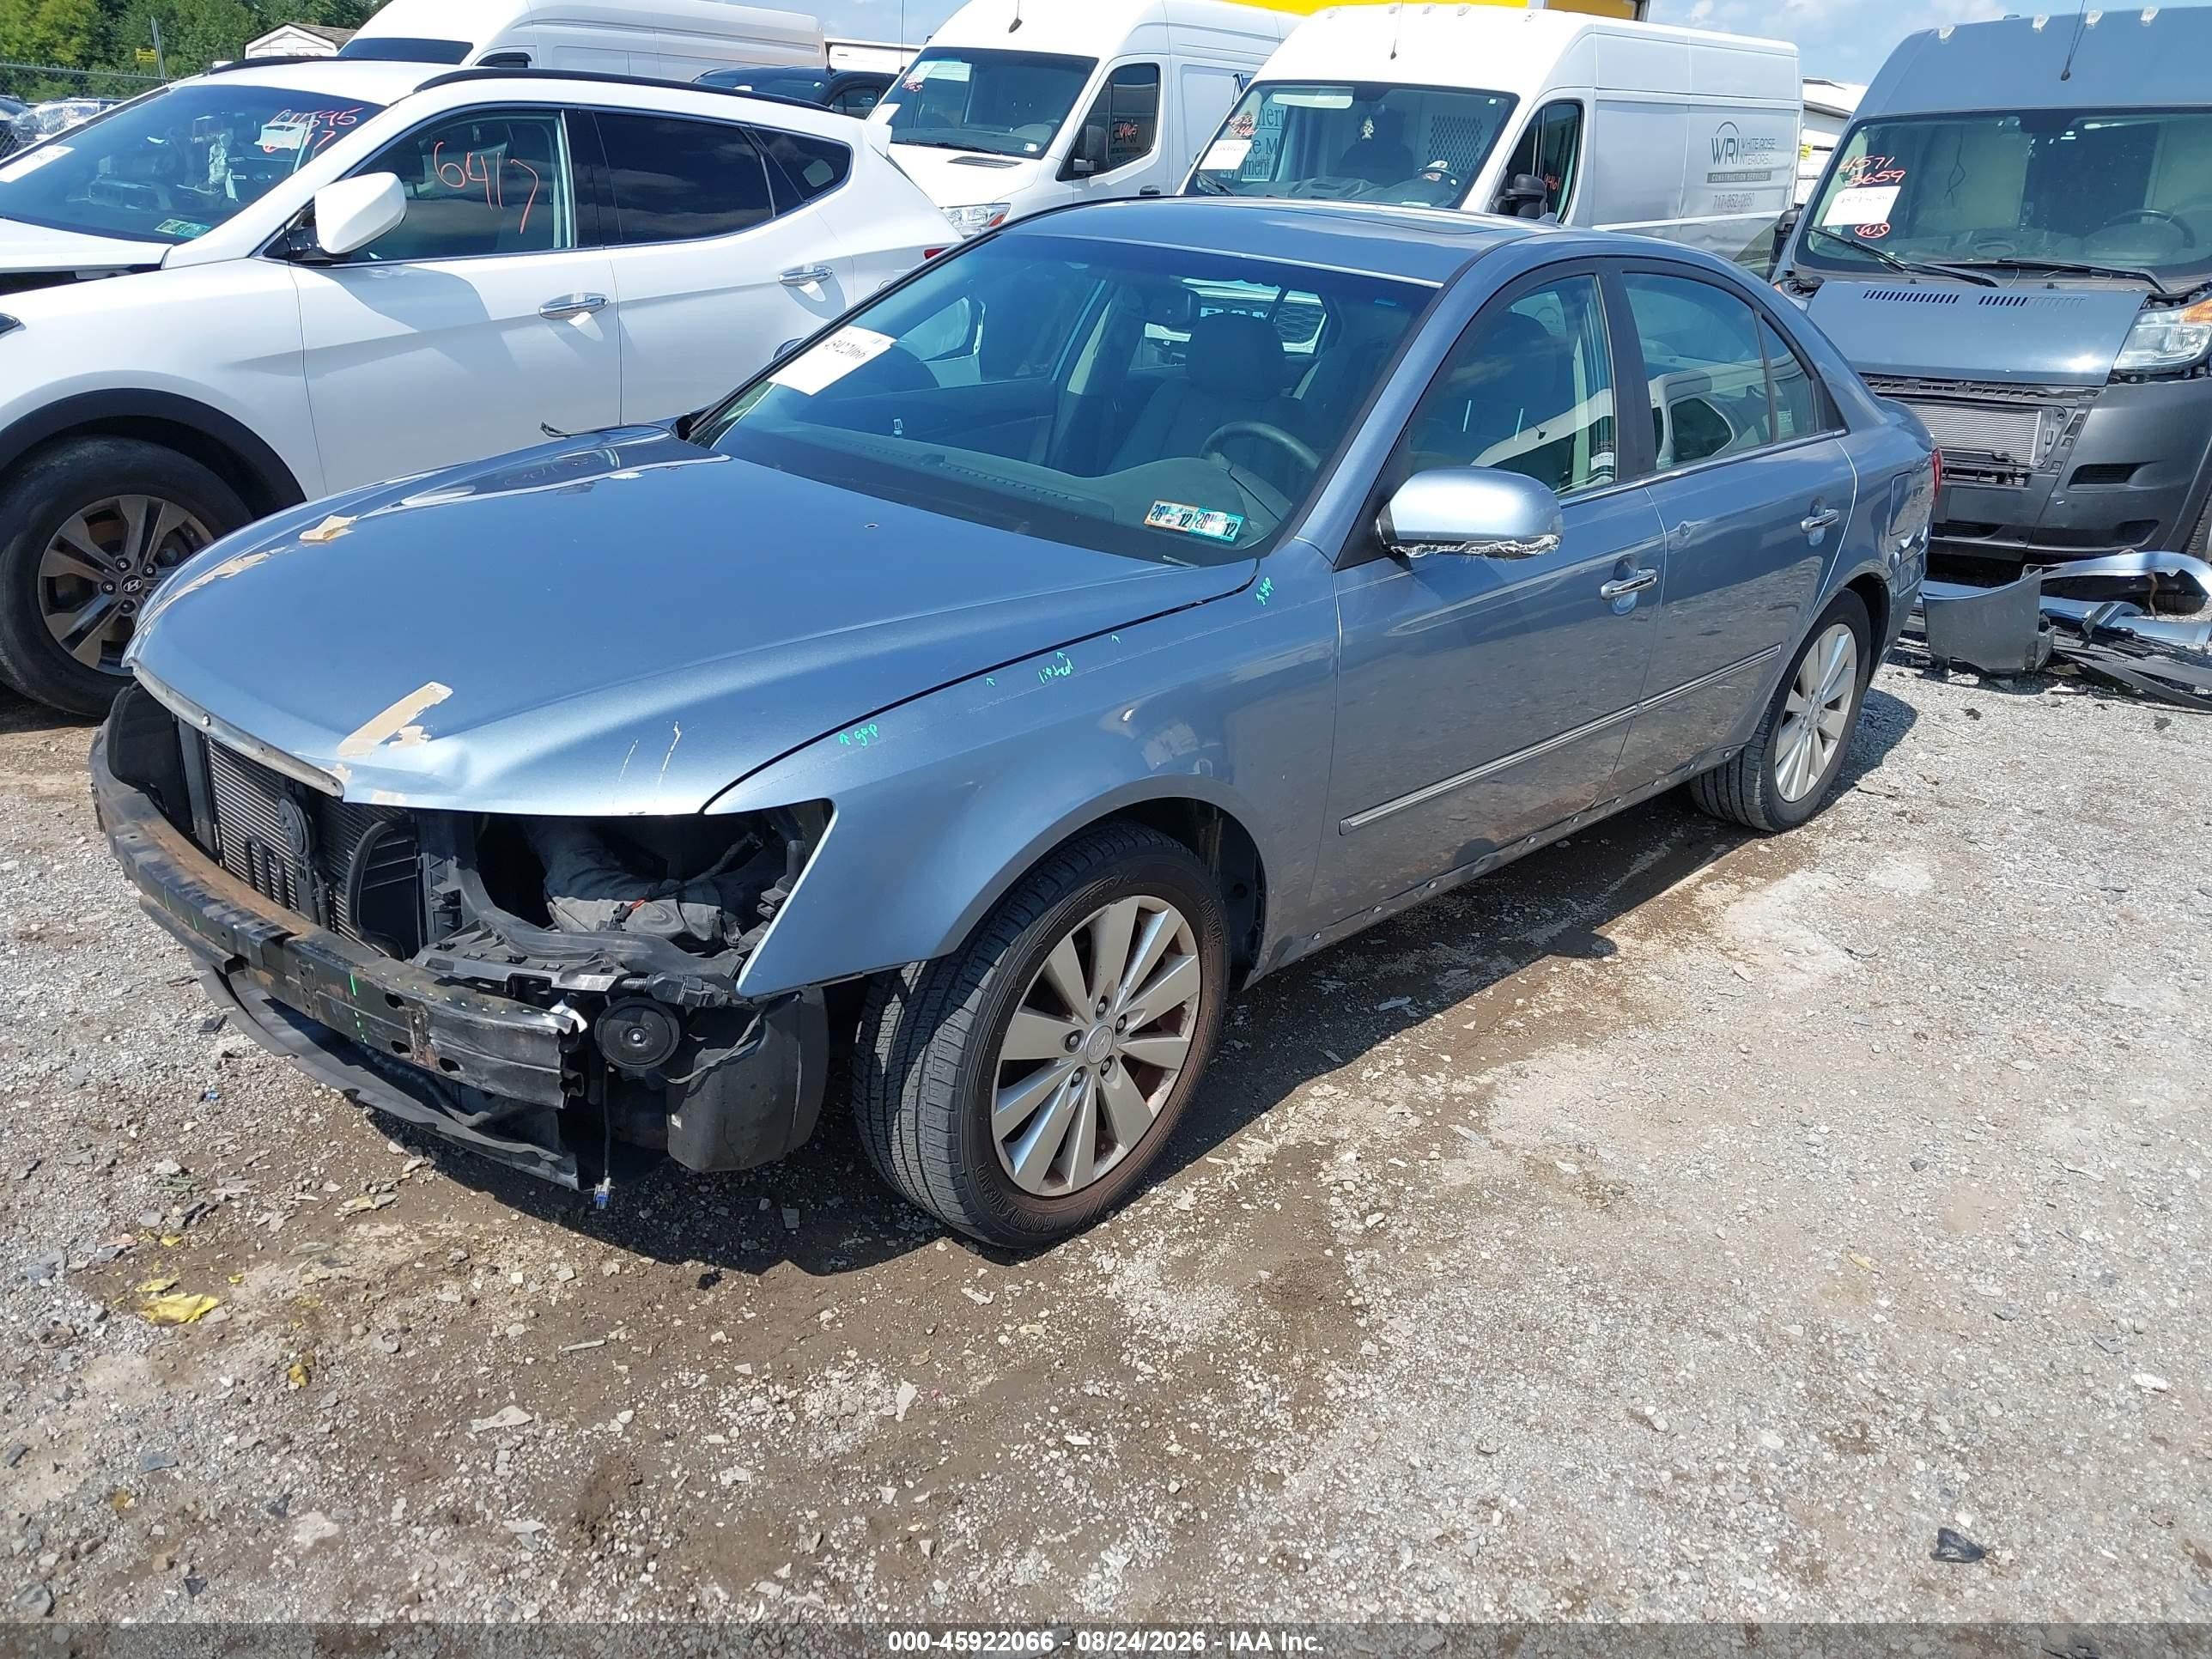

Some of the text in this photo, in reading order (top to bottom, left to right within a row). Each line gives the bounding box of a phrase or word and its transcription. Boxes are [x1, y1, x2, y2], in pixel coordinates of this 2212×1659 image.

[1711, 137, 1740, 166] WRI
[1840, 155, 1895, 173] 4571
[434, 141, 539, 234] 6417
[1845, 170, 1906, 188] 3659
[1179, 513, 1193, 528] 12
[1224, 521, 1237, 538] 12
